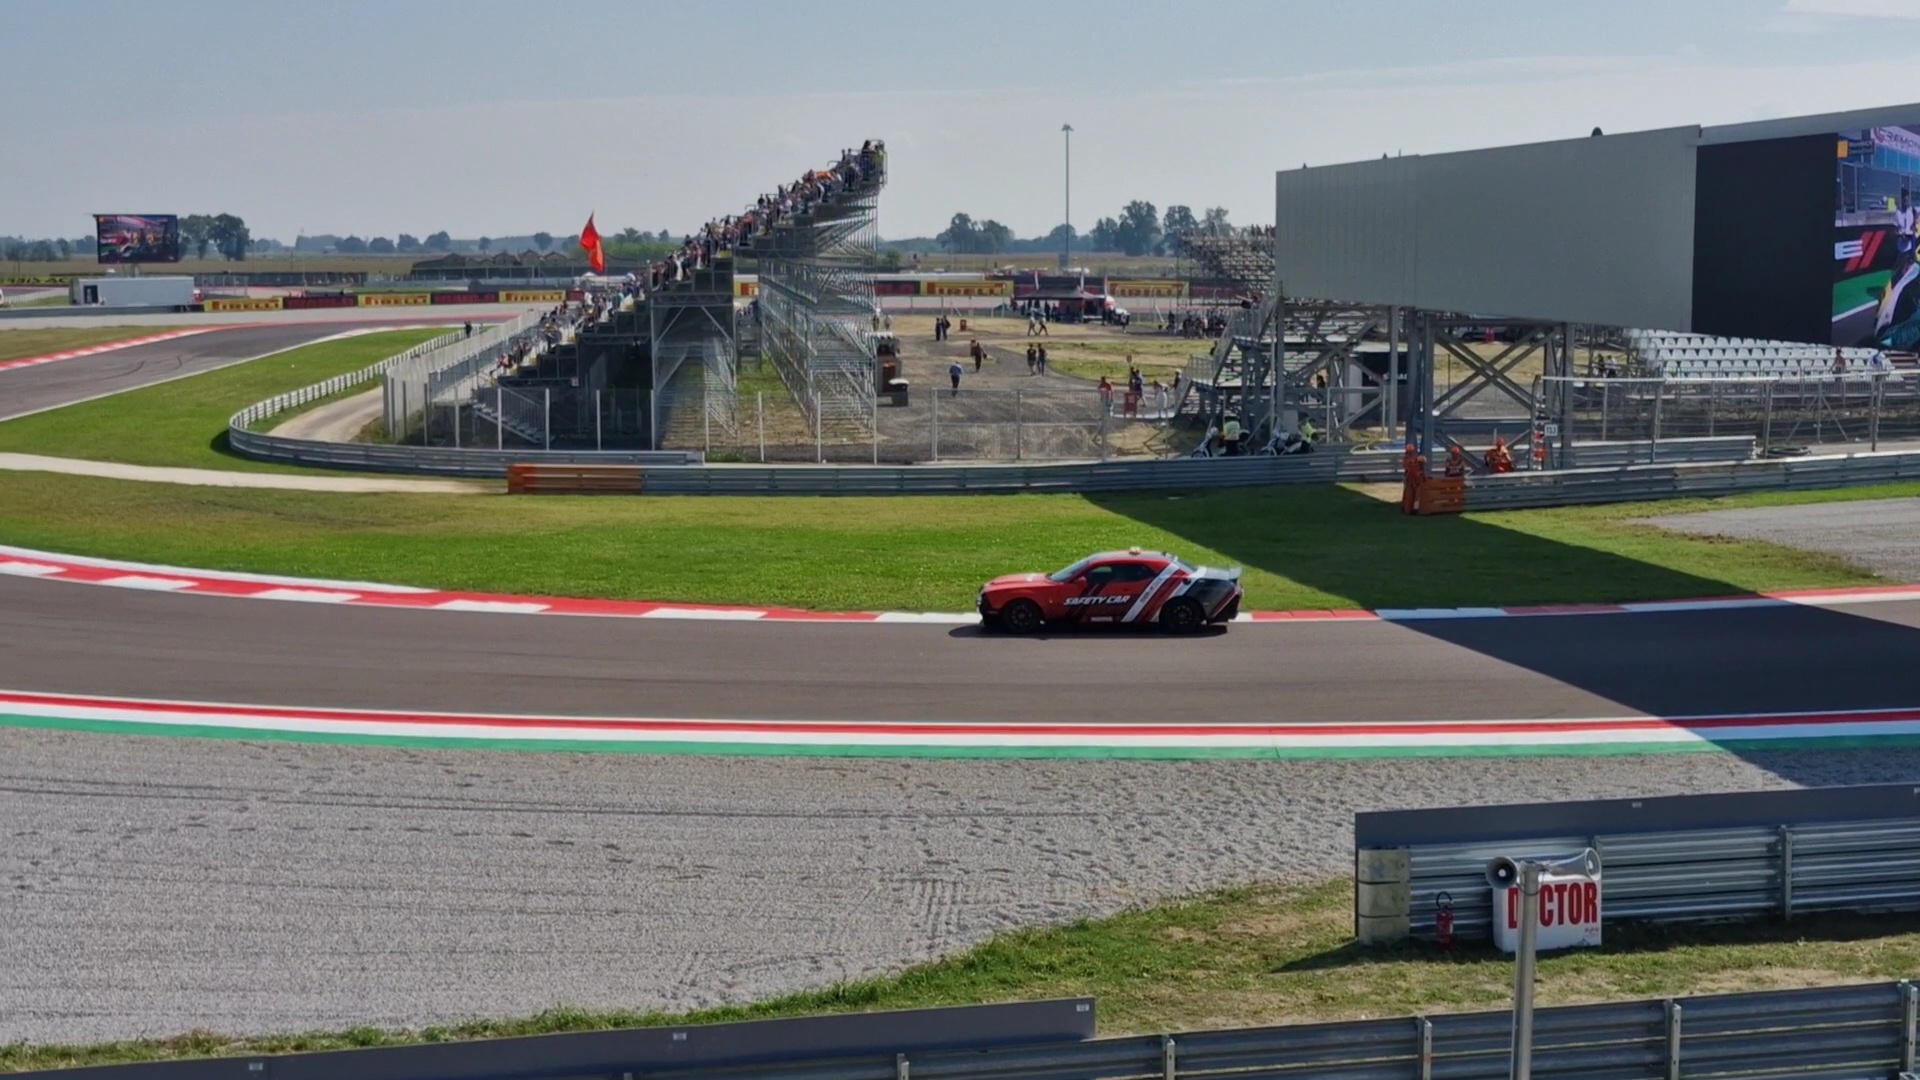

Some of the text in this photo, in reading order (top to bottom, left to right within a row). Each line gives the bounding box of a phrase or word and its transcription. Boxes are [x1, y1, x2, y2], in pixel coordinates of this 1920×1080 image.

[1063, 595, 1131, 606] SAFETY CAR
[1508, 882, 1598, 929] DCTOR
